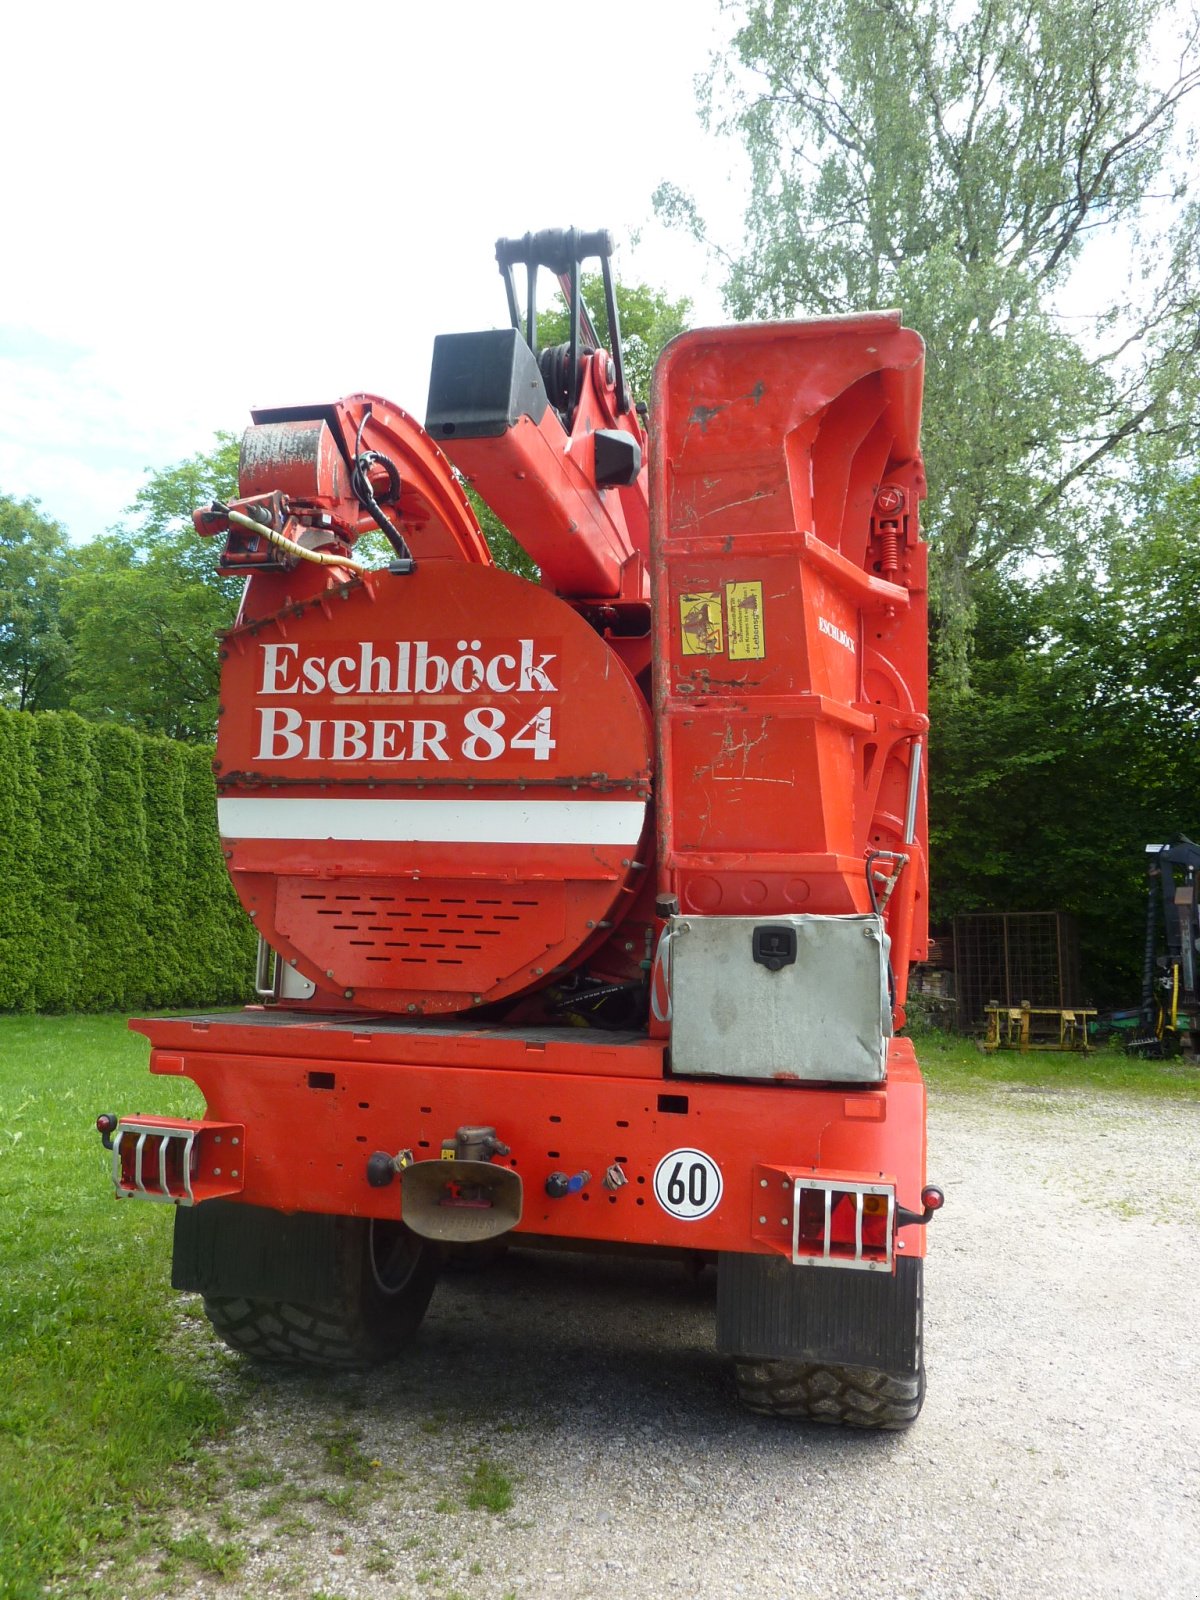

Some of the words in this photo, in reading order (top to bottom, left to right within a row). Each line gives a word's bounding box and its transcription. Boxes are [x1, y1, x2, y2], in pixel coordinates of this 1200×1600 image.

[257, 639, 558, 694] Eschlböck
[253, 707, 452, 760] BIBER
[461, 706, 556, 761] 84
[667, 1162, 706, 1206] 60
